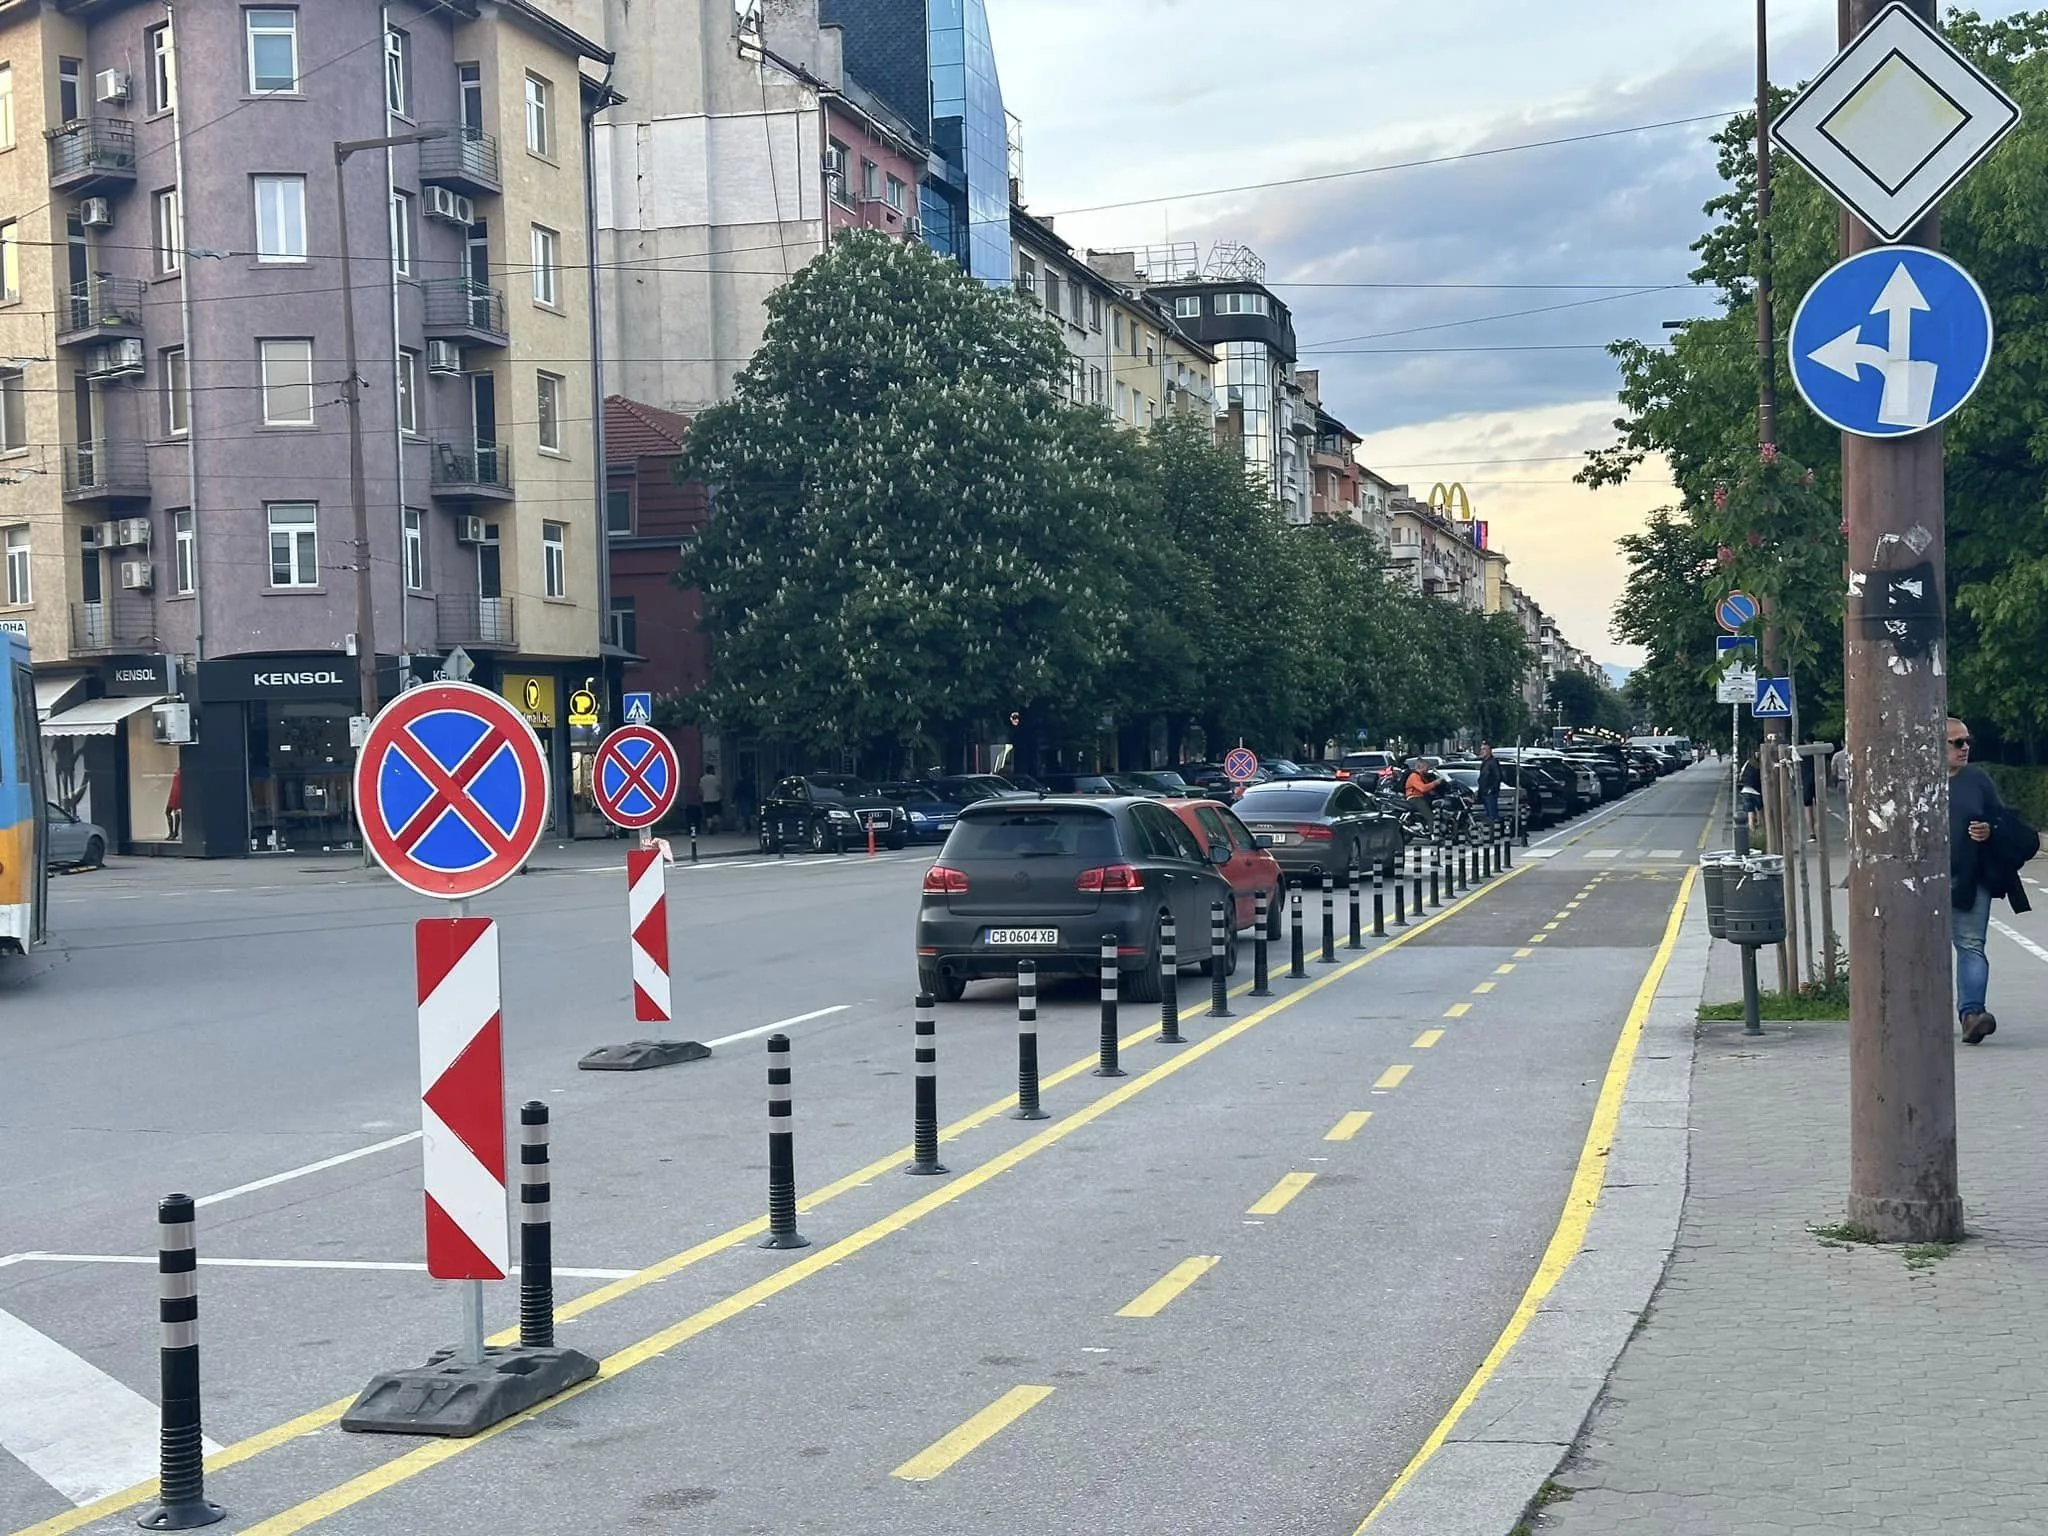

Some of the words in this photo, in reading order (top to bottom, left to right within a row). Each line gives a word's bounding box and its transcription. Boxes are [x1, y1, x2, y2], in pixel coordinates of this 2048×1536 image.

[0, 623, 24, 632] ОНА
[115, 669, 156, 681] KENSOL
[254, 671, 344, 686] KENSOL
[992, 931, 1007, 942] CB
[1009, 931, 1038, 942] 0604
[1040, 931, 1055, 942] XB
